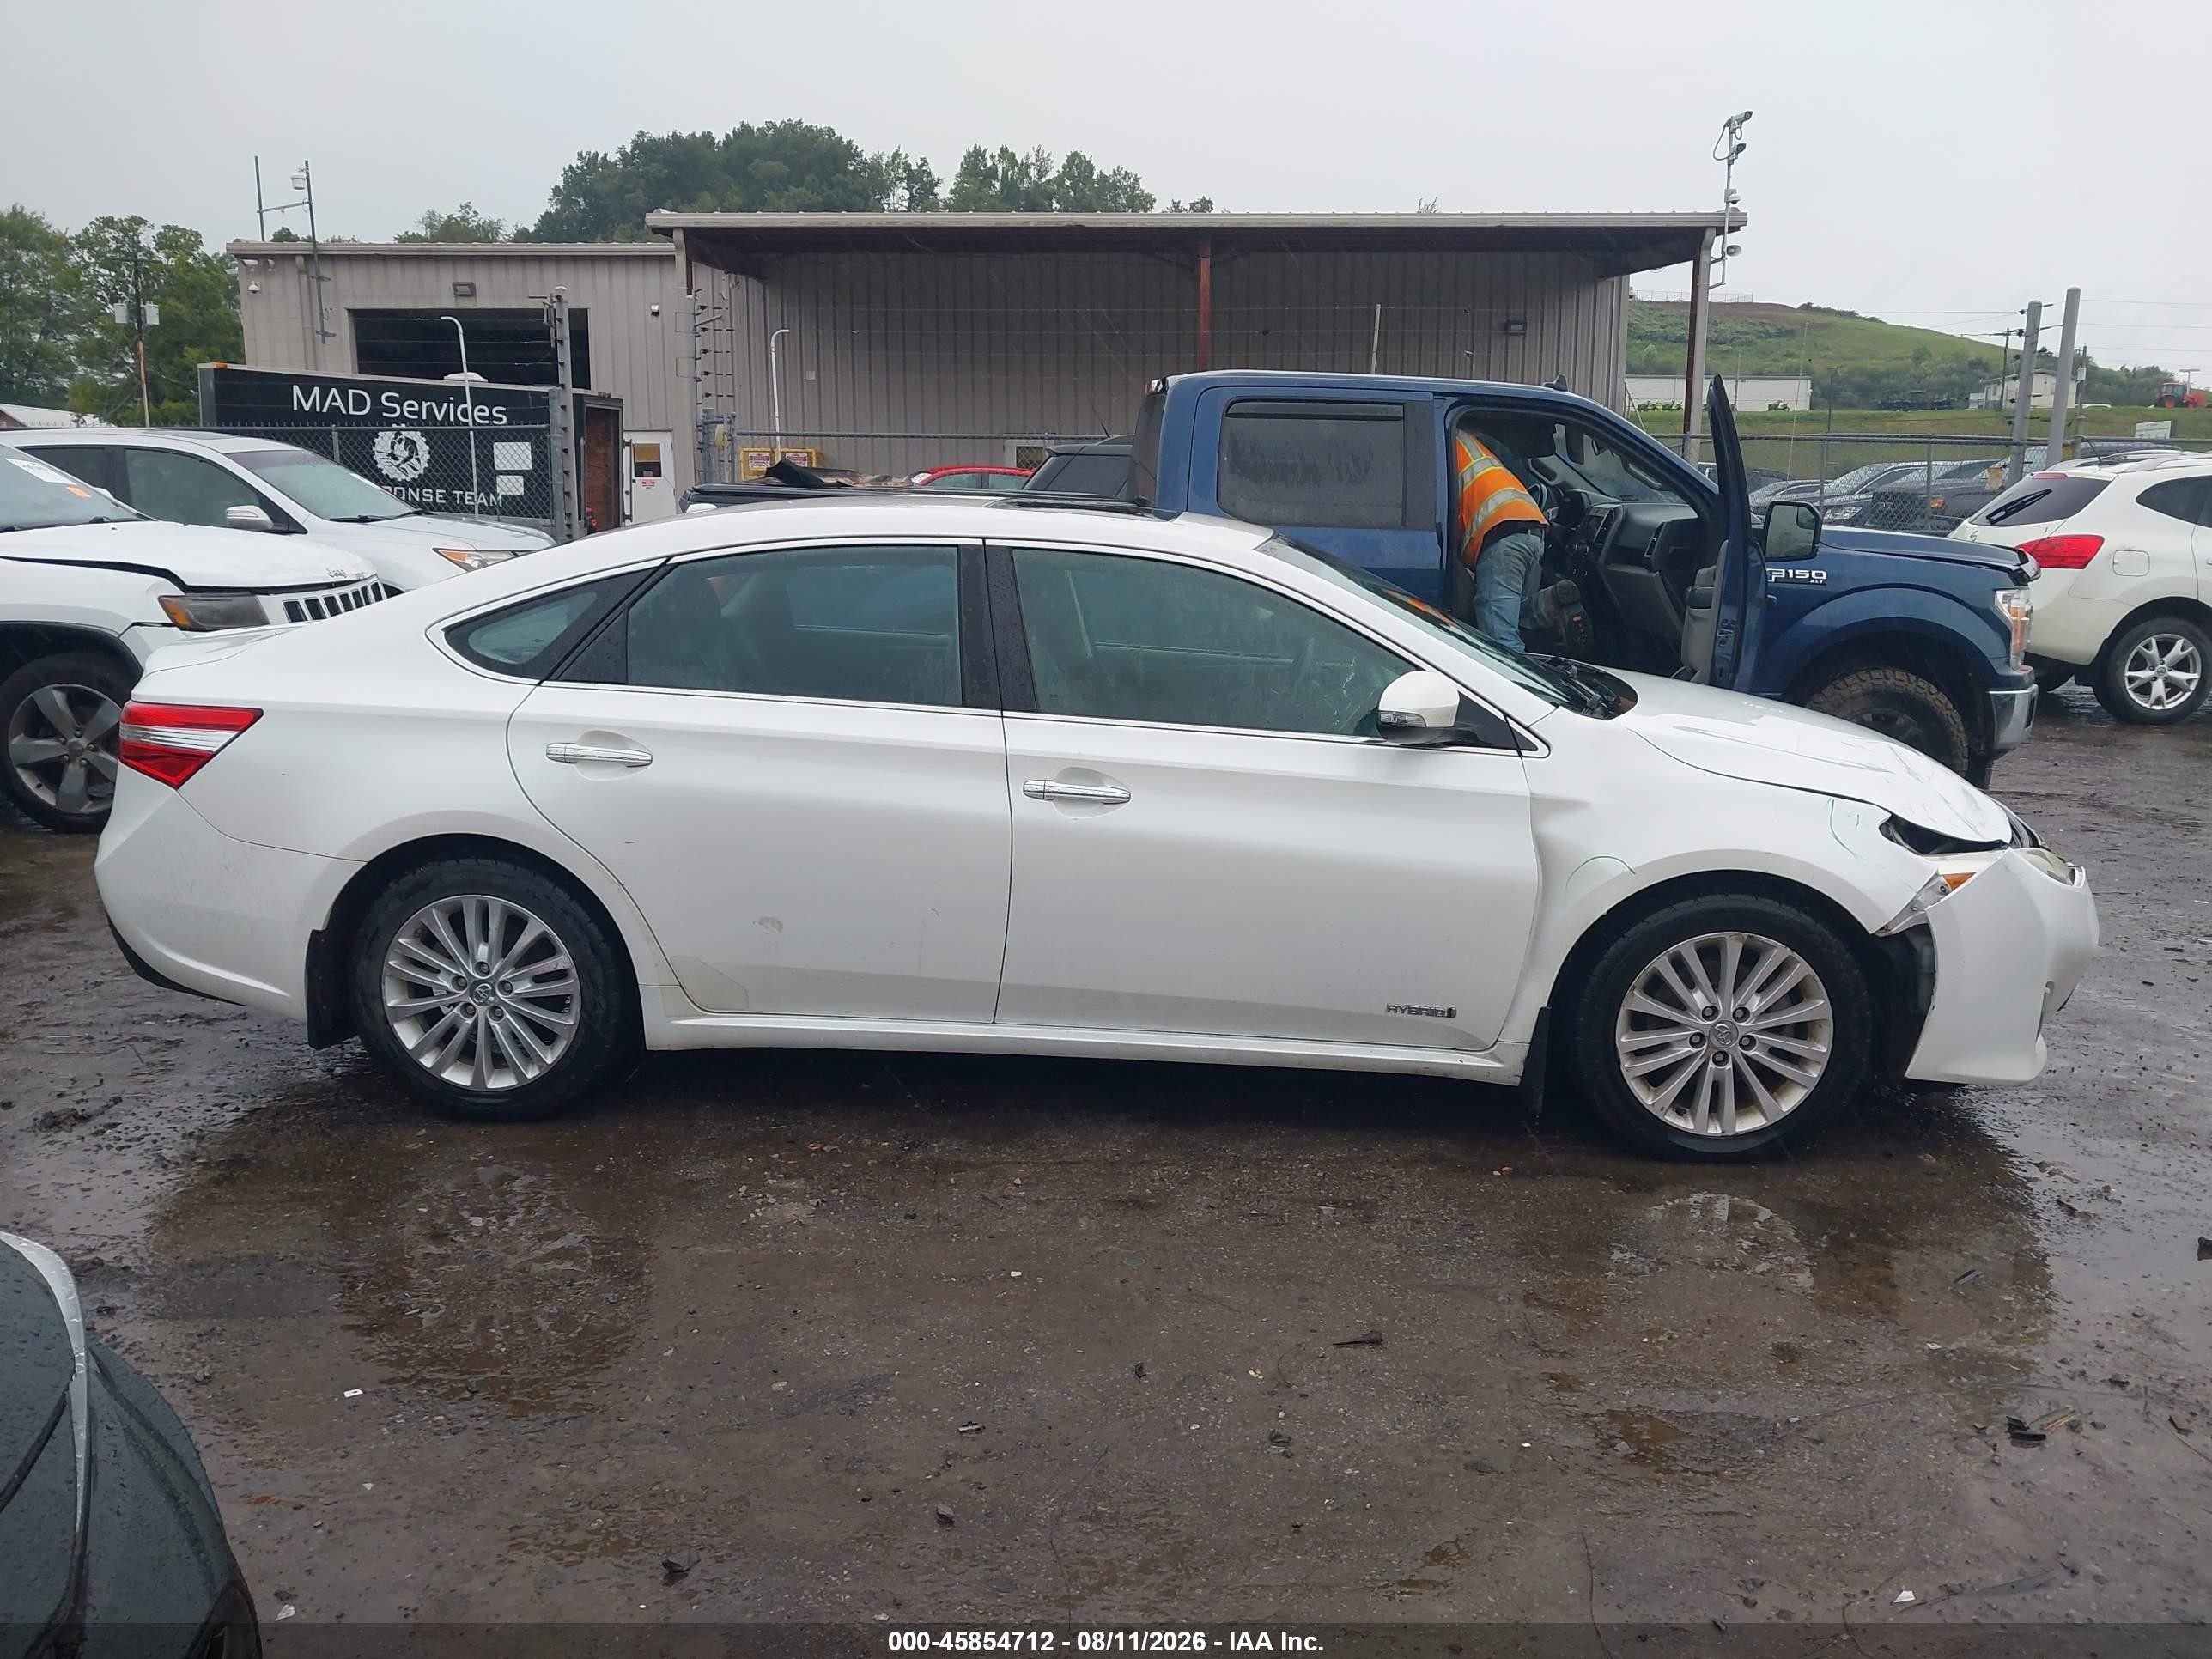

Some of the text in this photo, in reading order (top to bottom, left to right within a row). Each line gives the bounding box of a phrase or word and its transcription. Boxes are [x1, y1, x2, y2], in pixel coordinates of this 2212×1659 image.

[292, 385, 508, 425] MAD Services
[453, 489, 502, 507] TEAM
